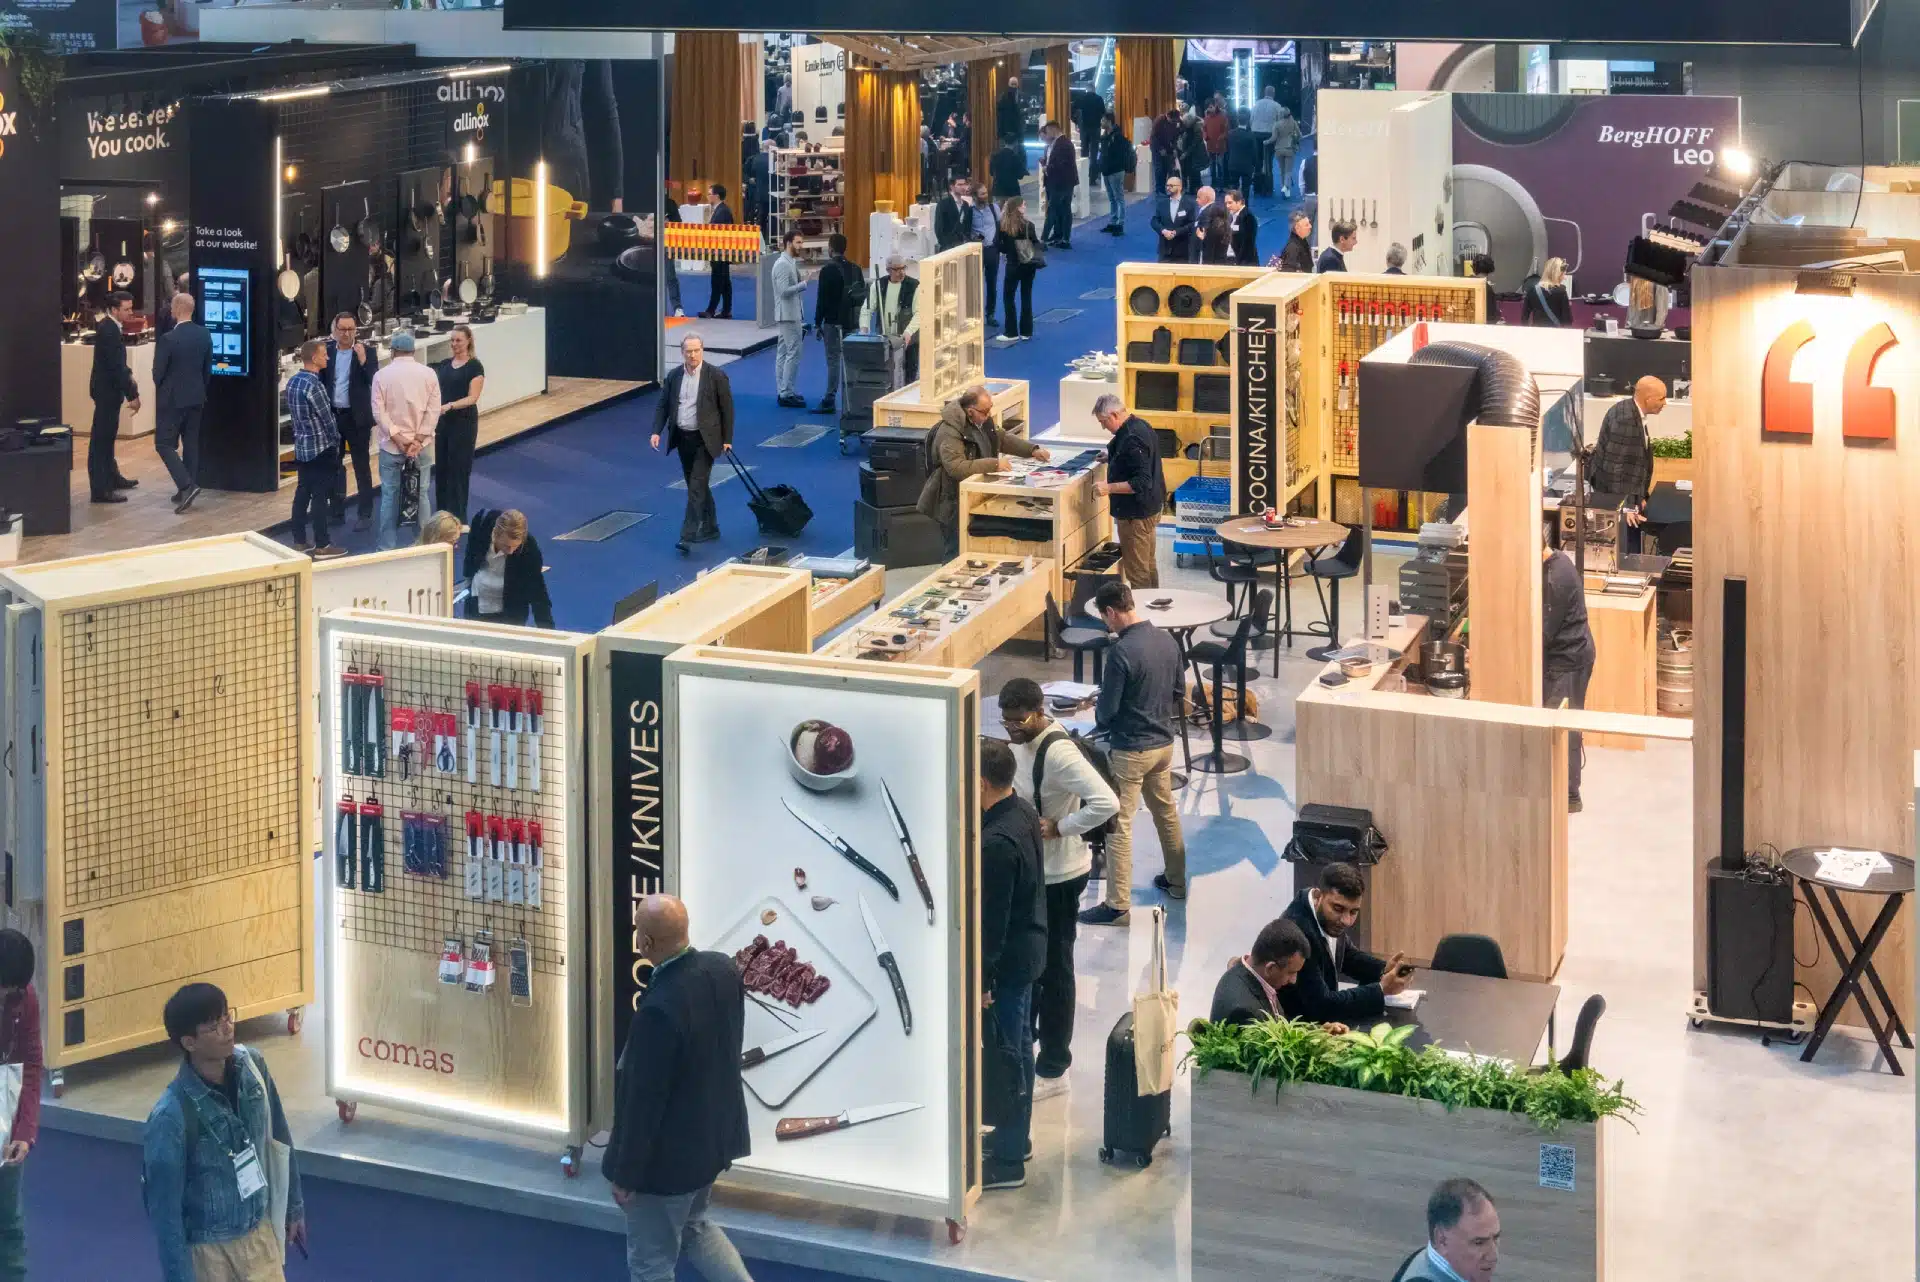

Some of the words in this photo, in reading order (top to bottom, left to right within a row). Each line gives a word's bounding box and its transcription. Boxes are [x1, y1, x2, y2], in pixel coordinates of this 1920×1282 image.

[453, 112, 490, 132] allinox
[87, 136, 121, 159] You
[125, 126, 170, 153] cook.
[1597, 125, 1714, 148] BergHOFF
[195, 226, 215, 236] Take
[224, 227, 243, 237] look
[195, 239, 205, 247] at
[222, 239, 258, 250] website!
[1248, 316, 1267, 516] COCINA/KITCHEN
[630, 699, 661, 1012] OE/KNIVES
[358, 1036, 455, 1074] comas
